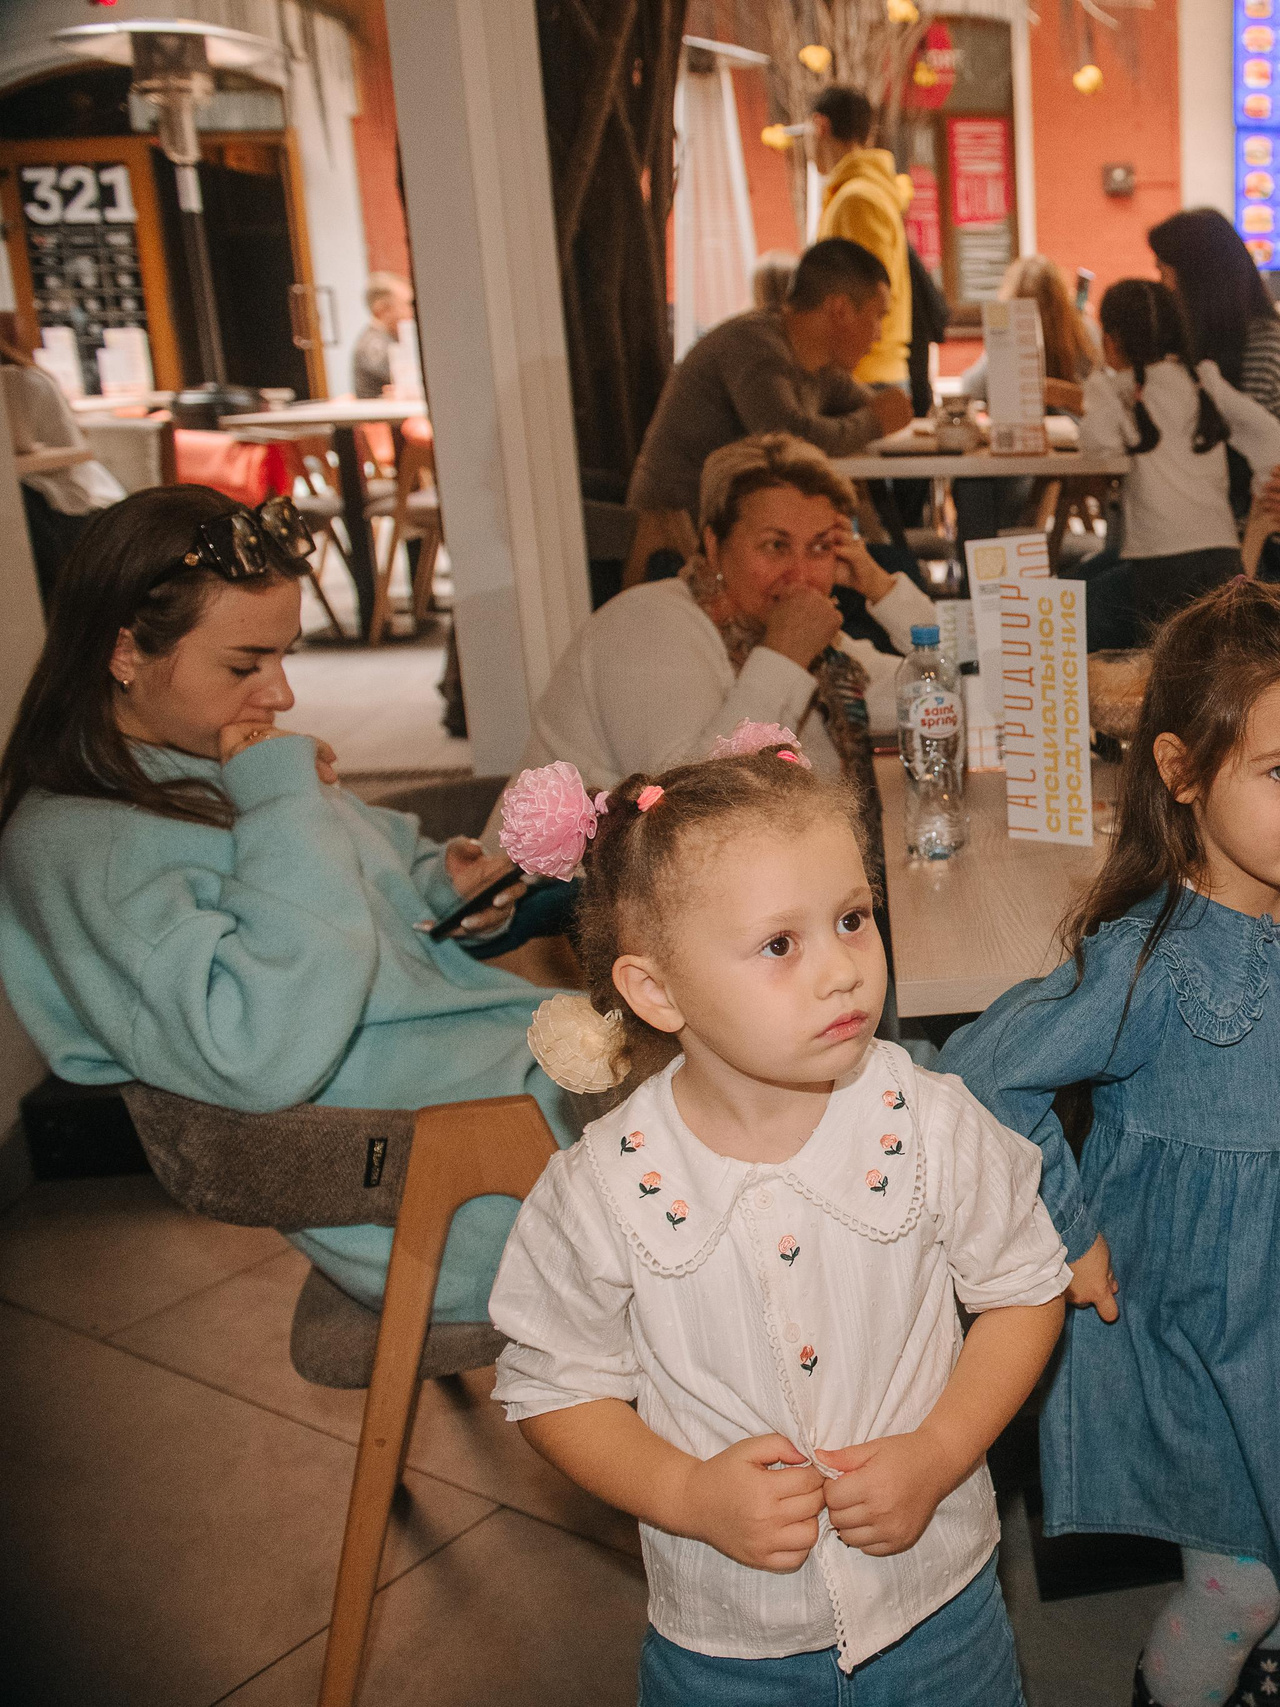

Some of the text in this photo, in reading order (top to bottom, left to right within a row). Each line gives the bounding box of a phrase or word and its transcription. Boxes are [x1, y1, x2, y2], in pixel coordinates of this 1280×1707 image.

[22, 165, 138, 225] 321
[1037, 597, 1062, 834] специальное
[1060, 589, 1088, 837] предложение
